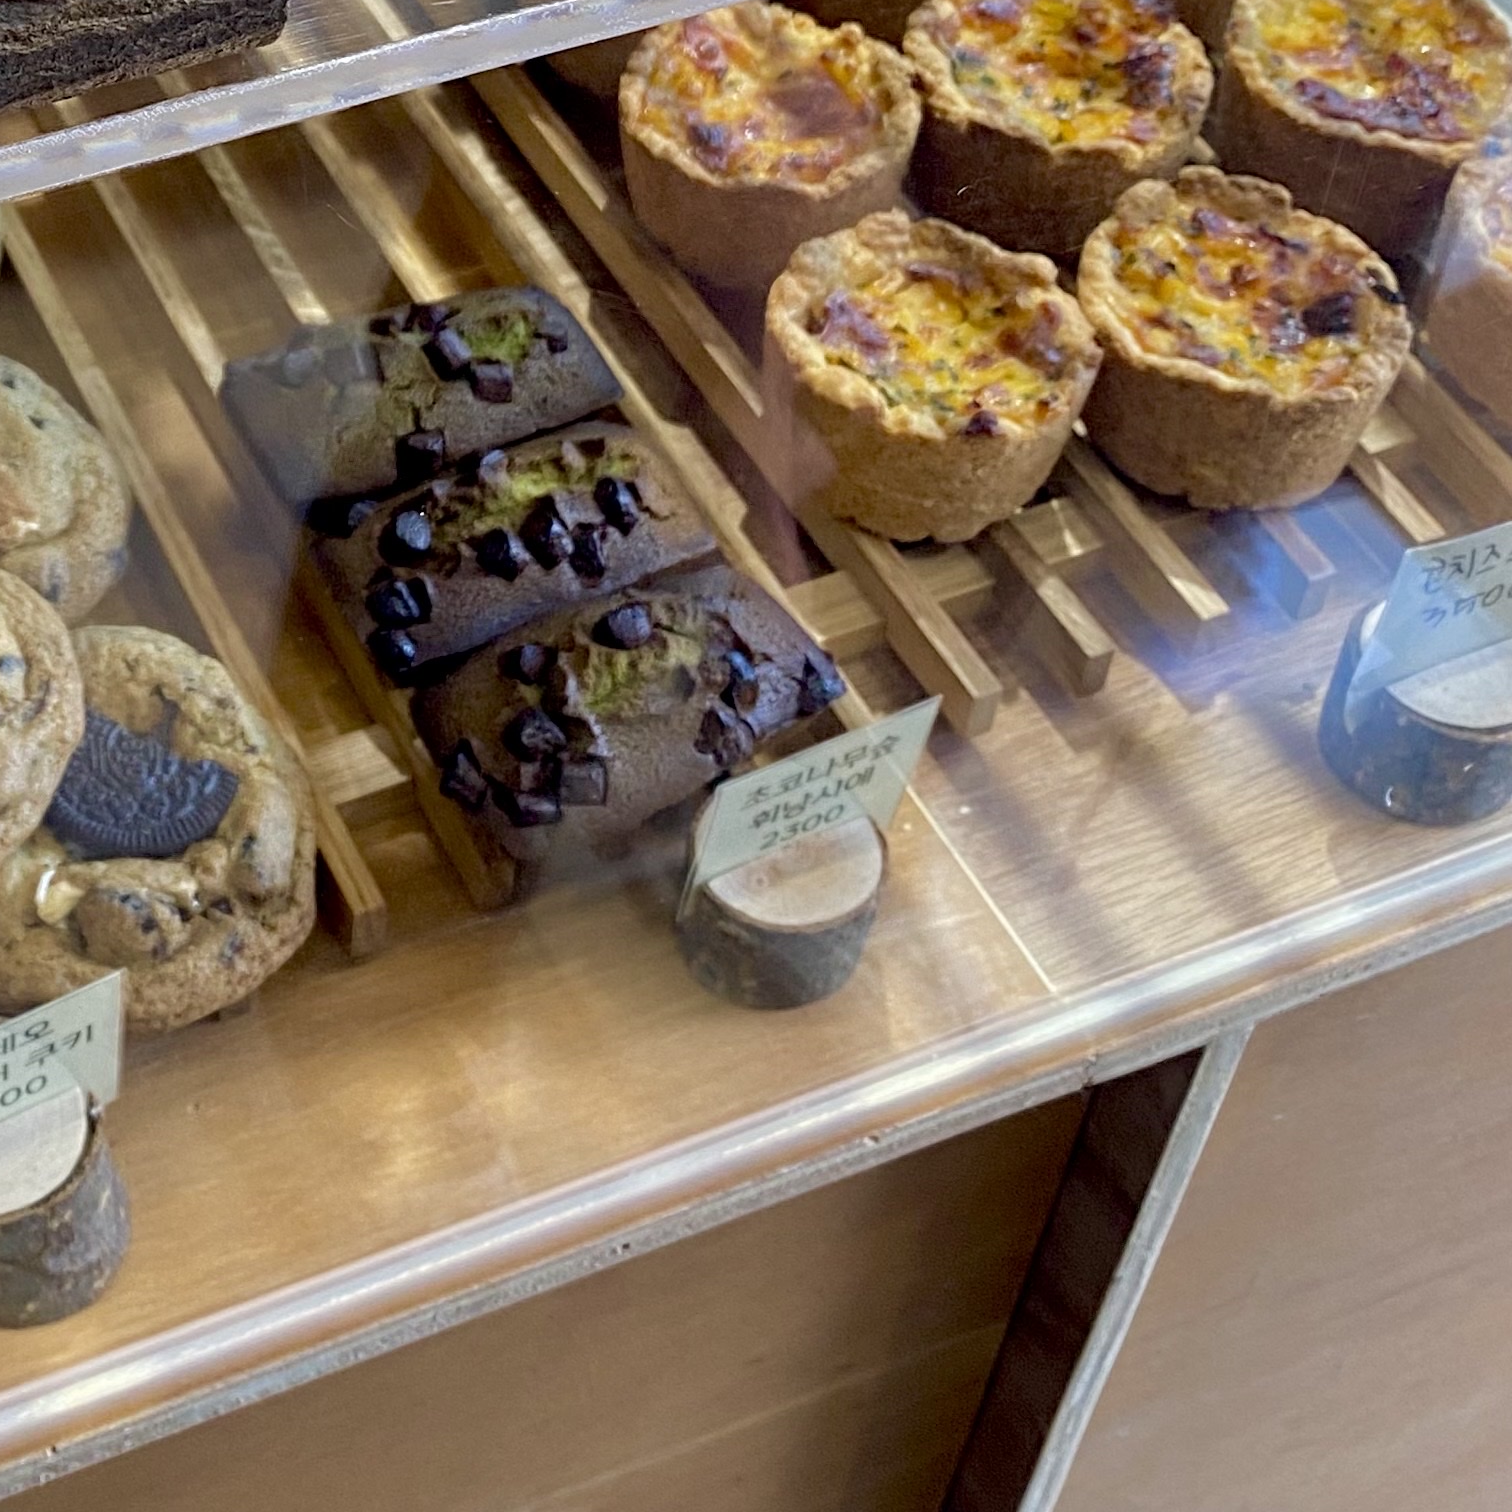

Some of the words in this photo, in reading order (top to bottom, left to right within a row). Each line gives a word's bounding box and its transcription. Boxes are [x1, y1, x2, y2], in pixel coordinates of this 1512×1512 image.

[1422, 584, 1512, 628] 350
[759, 804, 846, 851] 2300
[24, 1024, 94, 1067] 쿠키
